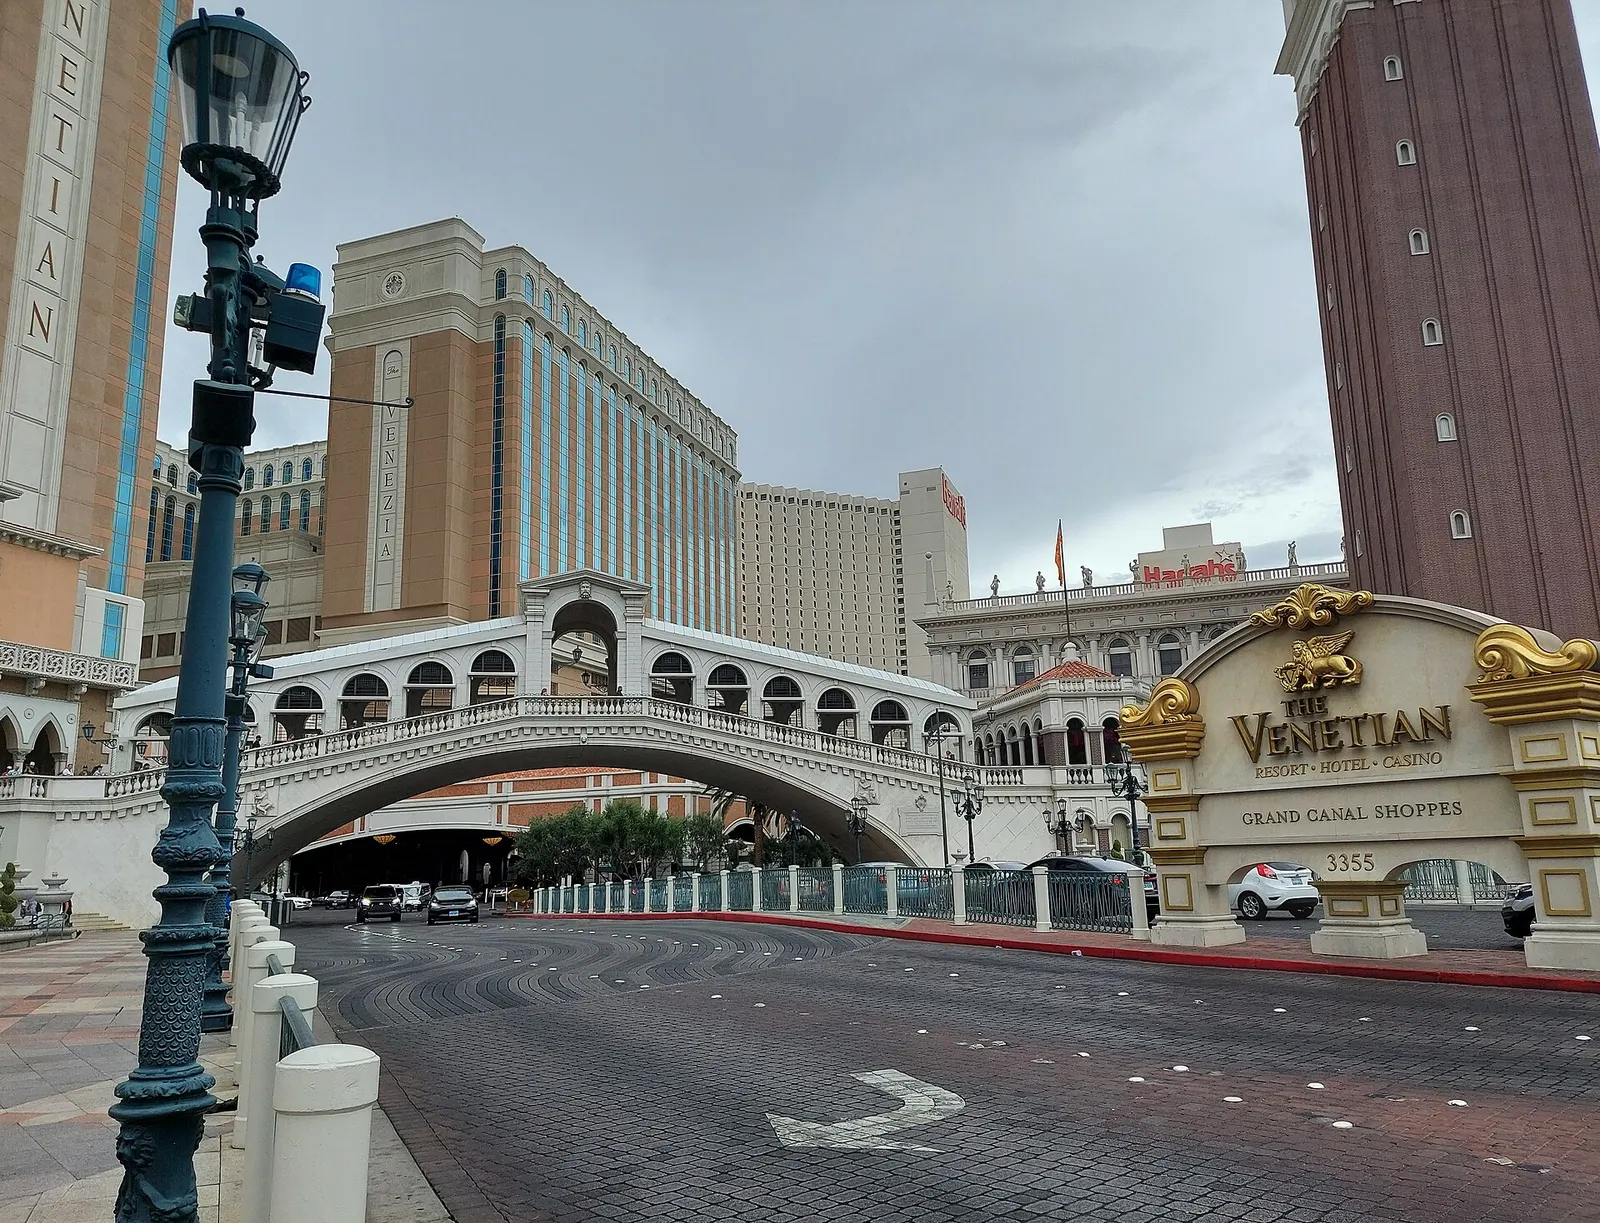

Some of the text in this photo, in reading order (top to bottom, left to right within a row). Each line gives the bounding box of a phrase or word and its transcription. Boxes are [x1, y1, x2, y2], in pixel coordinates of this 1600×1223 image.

[381, 402, 398, 557] VENEZIA
[1280, 696, 1329, 717] THE
[1227, 704, 1452, 764] VENETIAN
[1255, 751, 1443, 779] RESORT HOTEL CASINO
[1242, 801, 1463, 826] GRAND CANAL SHOPPES
[1327, 853, 1375, 872] 3355
